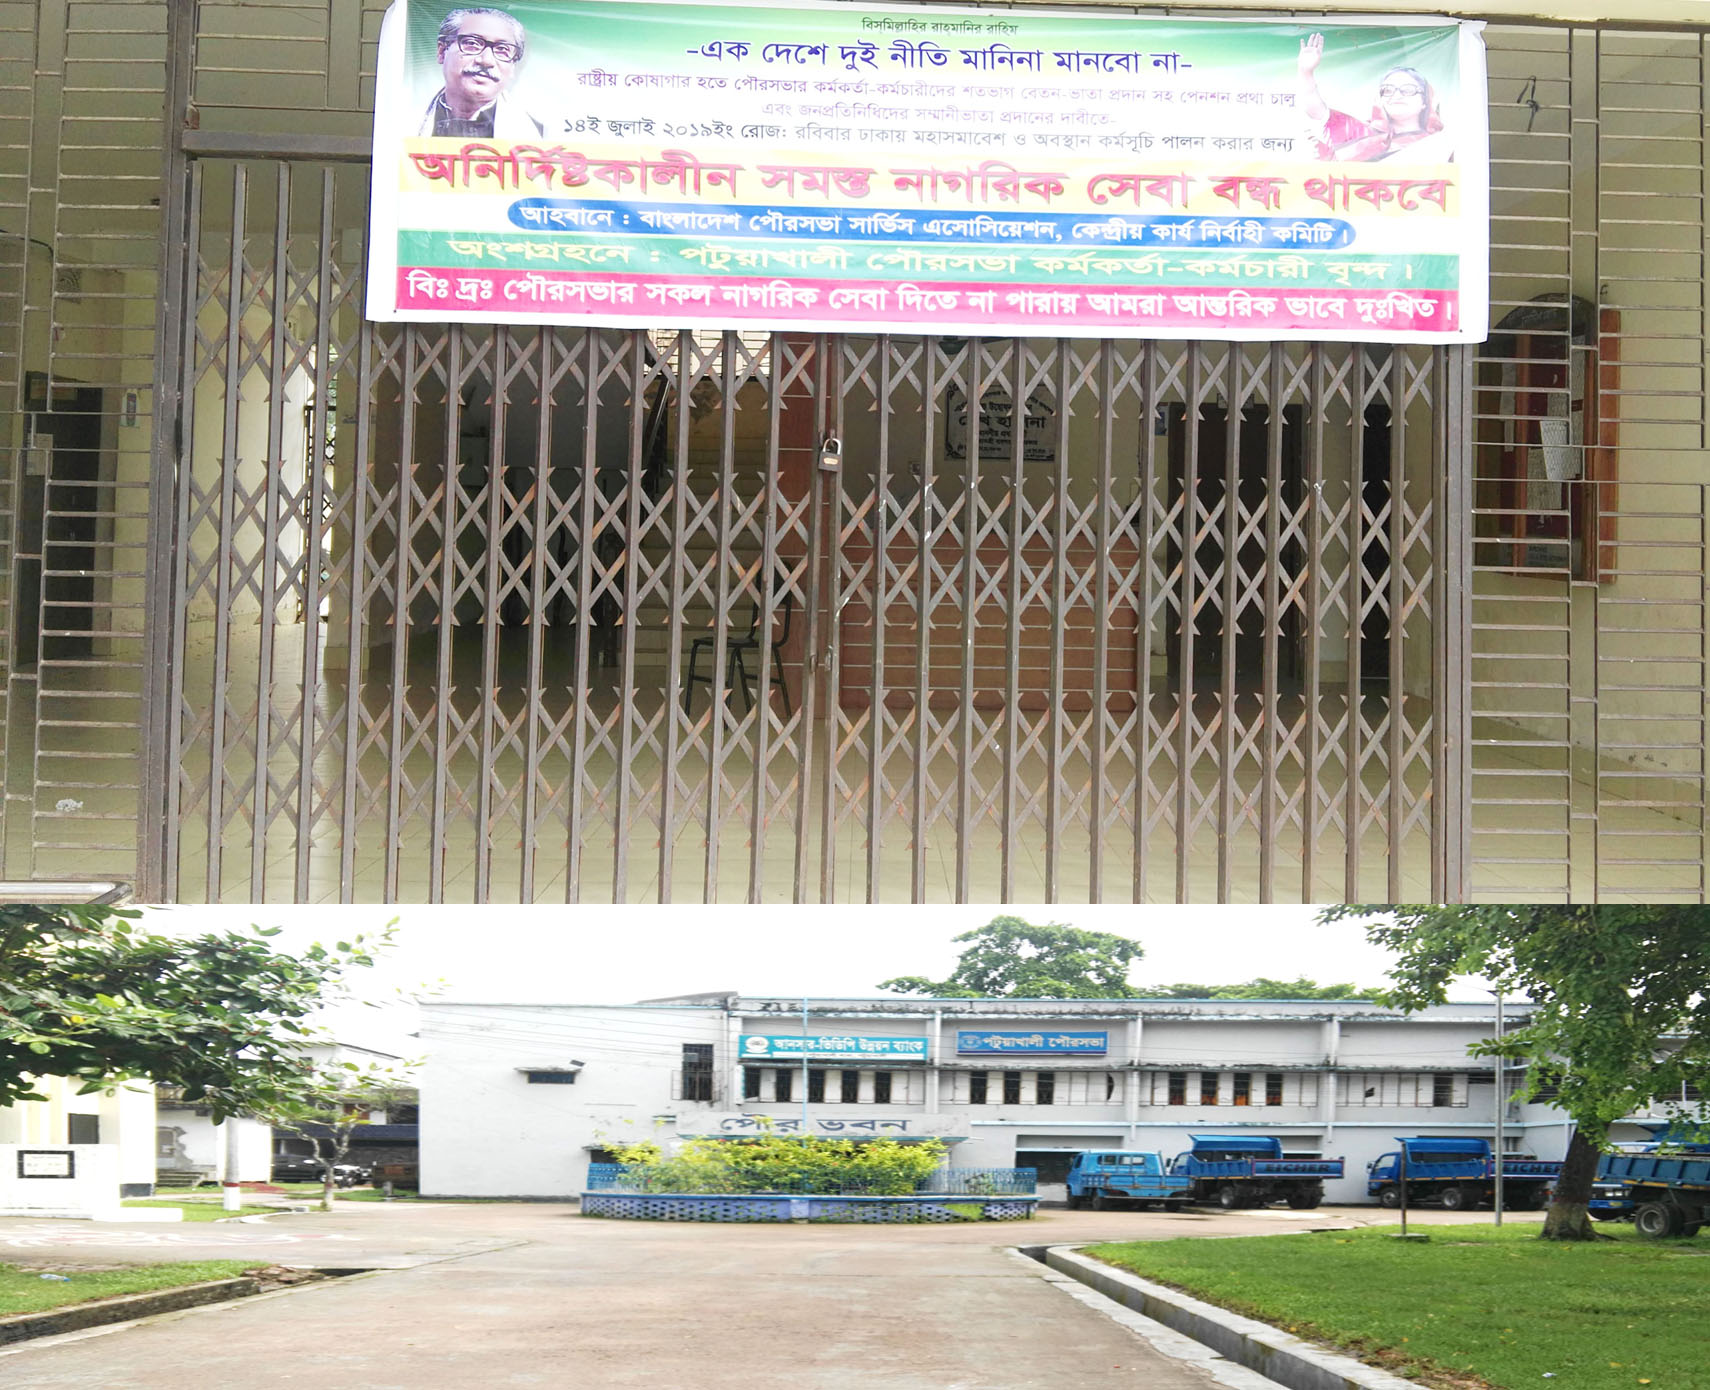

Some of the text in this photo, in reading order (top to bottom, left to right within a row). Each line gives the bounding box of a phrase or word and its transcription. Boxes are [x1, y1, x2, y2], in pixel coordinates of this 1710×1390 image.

[762, 43, 829, 66] দেশে
[839, 39, 879, 70] দুই
[888, 40, 951, 68] নীতি
[960, 43, 1043, 72] মানিনা
[1052, 52, 1142, 73] মানবো
[577, 68, 618, 88] রাষ্ট্রীয়
[624, 74, 691, 88] কোষাগার
[697, 76, 728, 89] হতে
[734, 76, 807, 92] পৌরসভার
[962, 85, 1015, 99] শতভাগ
[1107, 89, 1147, 102] প্রদান
[1152, 89, 1174, 103] সহ
[1180, 90, 1232, 104] পেনশন
[1236, 92, 1265, 105] প্রথা
[1270, 93, 1297, 107] চালু
[762, 103, 792, 116] এবং
[999, 111, 1054, 124] প্রদানের
[607, 117, 656, 137] জুলাই
[663, 120, 734, 139] ২০১৯ইং
[795, 122, 852, 141] রবিবার
[859, 128, 907, 143] ঢাকায়
[913, 130, 1006, 146] মহাসমাবেশ
[1013, 133, 1026, 145] ও
[1033, 134, 1091, 149] অবস্থান
[1099, 131, 1155, 153] কর্মসূচি
[1162, 136, 1204, 149] পালন
[1211, 137, 1254, 150] করার
[1260, 138, 1296, 152] জন্য
[409, 142, 1455, 212] অনির্দিষ্টকালীন সমস্ত নাগরিক সেবা বন্ধ থাকবে
[639, 210, 742, 231] বাংলাদেশ
[749, 211, 842, 234] পৌরসভা
[849, 212, 916, 236] সার্ভিস
[1071, 218, 1145, 243] কেন্দ্রীয়
[1151, 220, 1194, 241] কার্য
[1200, 220, 1265, 244] নির্বাহী
[1271, 222, 1338, 245] কমিটি
[866, 248, 1023, 274] পৌরসভা
[1324, 261, 1394, 287] বৃন্দ
[503, 272, 637, 304] পৌরসভার
[646, 281, 714, 307] সকল
[720, 280, 820, 309] নাগরিক
[827, 287, 890, 312] সেবা
[896, 283, 959, 313] দিতে
[965, 289, 999, 313] না
[1005, 290, 1083, 315] পারায়
[1087, 293, 1168, 318] আমরা
[1173, 289, 1278, 319] আন্তরিক
[1284, 294, 1347, 319] ভাবে
[1354, 292, 1439, 325] দুঃখিত
[1048, 1035, 1105, 1048] পৌরসভা
[816, 1118, 912, 1131] ভবন
[1264, 1163, 1330, 1173] EICHER
